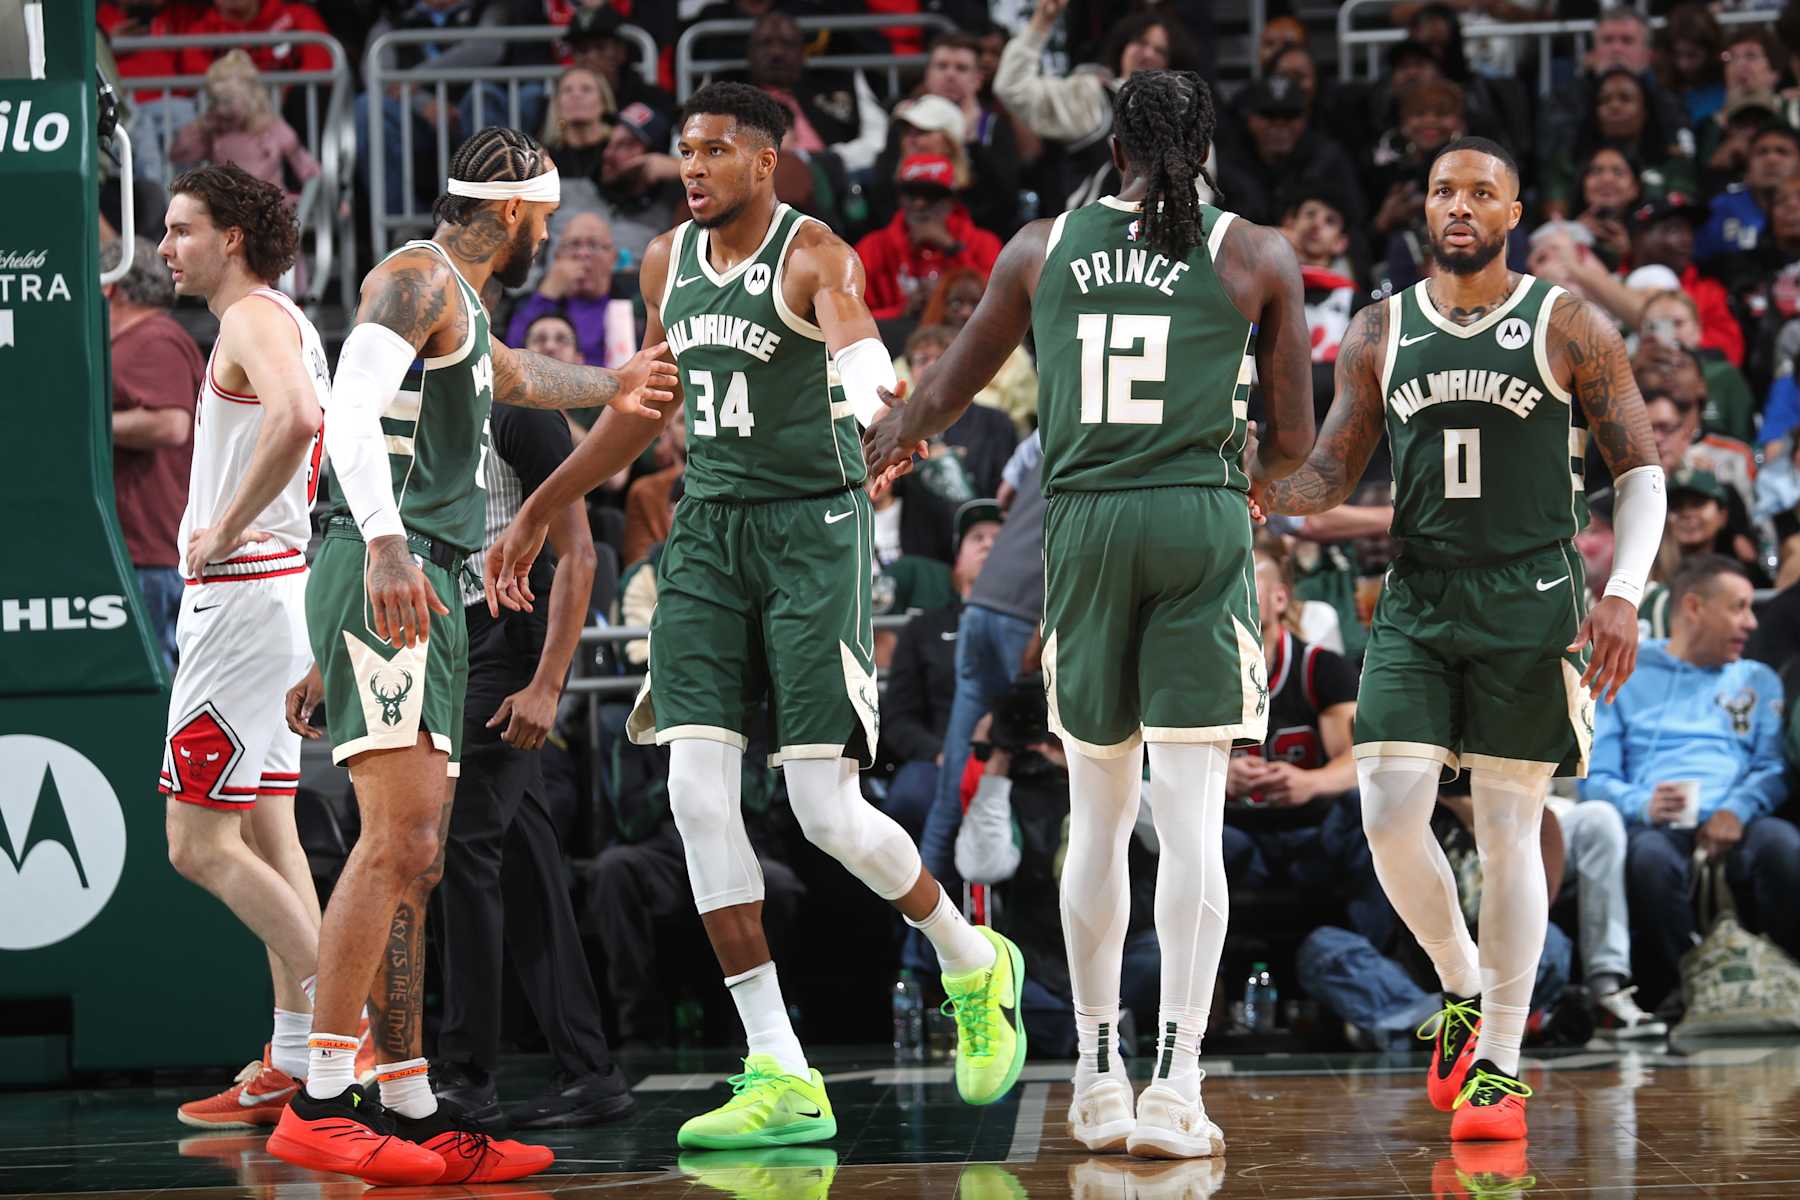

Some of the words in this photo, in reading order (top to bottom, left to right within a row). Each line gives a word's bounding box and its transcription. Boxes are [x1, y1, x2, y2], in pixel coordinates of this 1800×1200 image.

[0, 273, 71, 302] TRA
[1070, 249, 1190, 297] PRINCE
[666, 314, 781, 363] MILWAUKEE
[1076, 313, 1171, 424] 12
[688, 369, 755, 437] 34
[1389, 369, 1543, 424] MILWAUKEE
[1443, 428, 1481, 499] 0
[2, 594, 128, 632] HL'S
